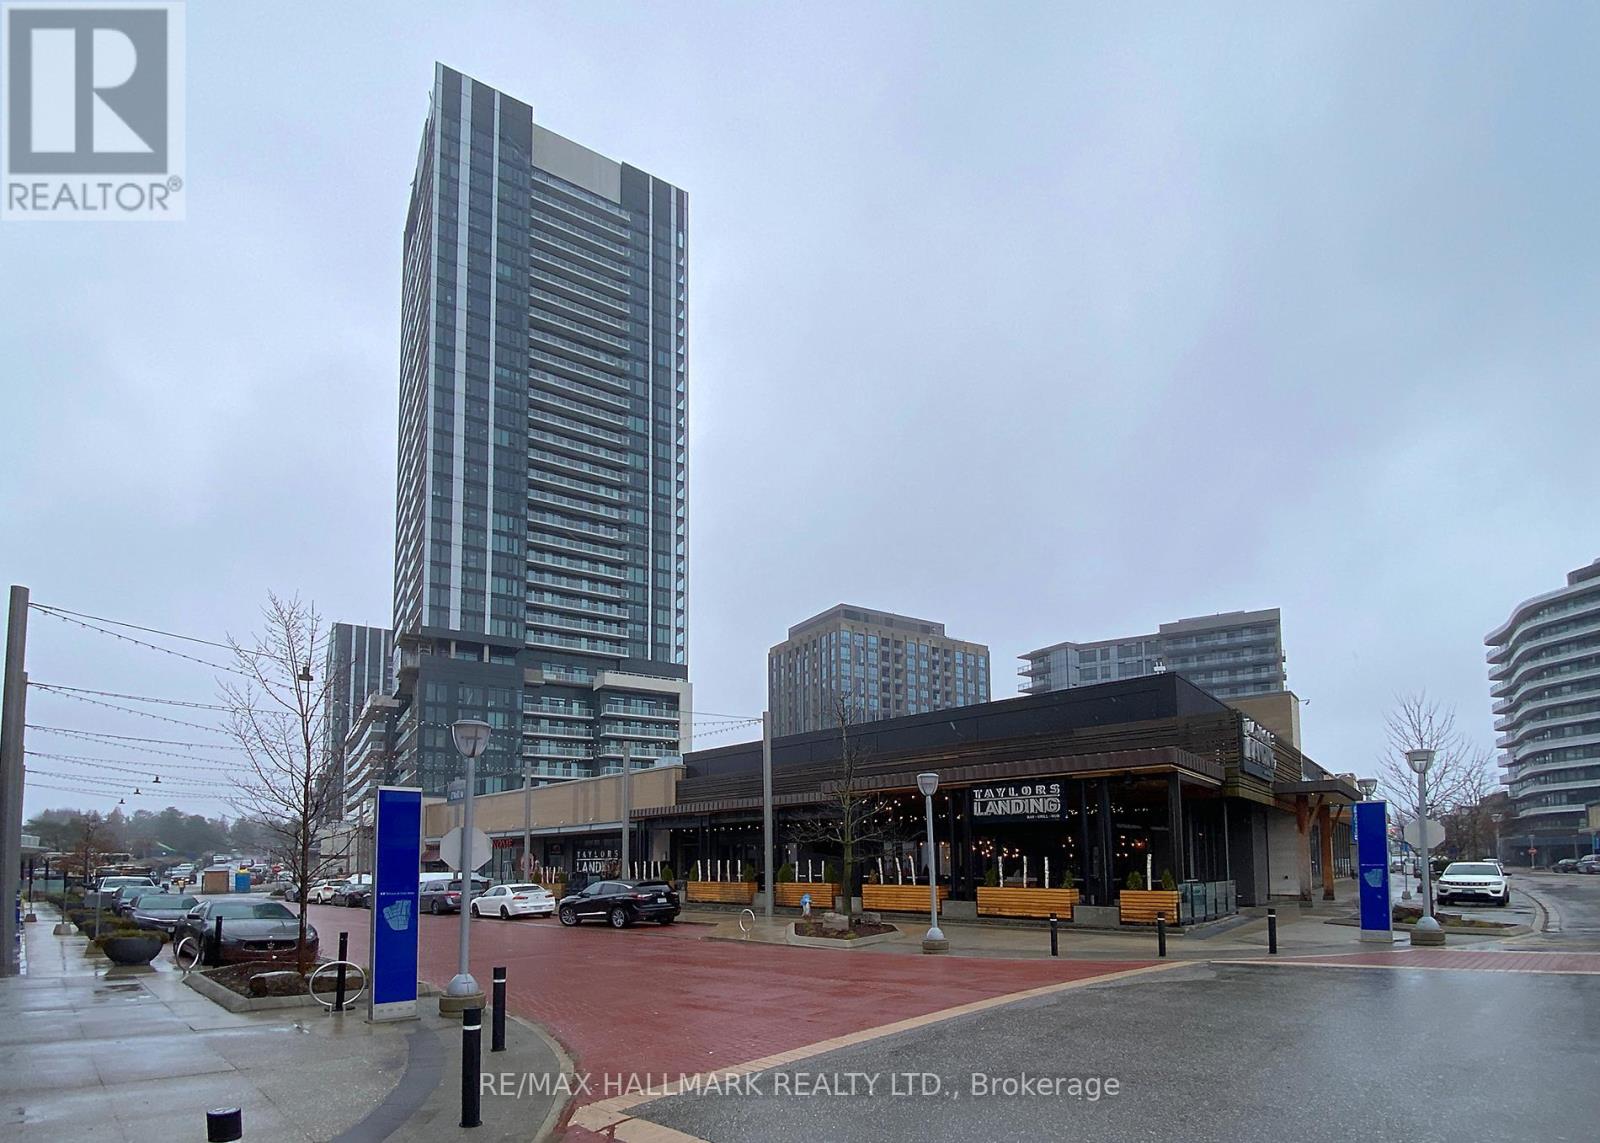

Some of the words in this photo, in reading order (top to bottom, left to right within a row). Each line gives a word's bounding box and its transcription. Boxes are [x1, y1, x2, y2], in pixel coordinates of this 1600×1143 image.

[973, 784, 1061, 799] TAYLORS
[973, 797, 1061, 817] LANDING
[577, 849, 619, 858] TAYLORS
